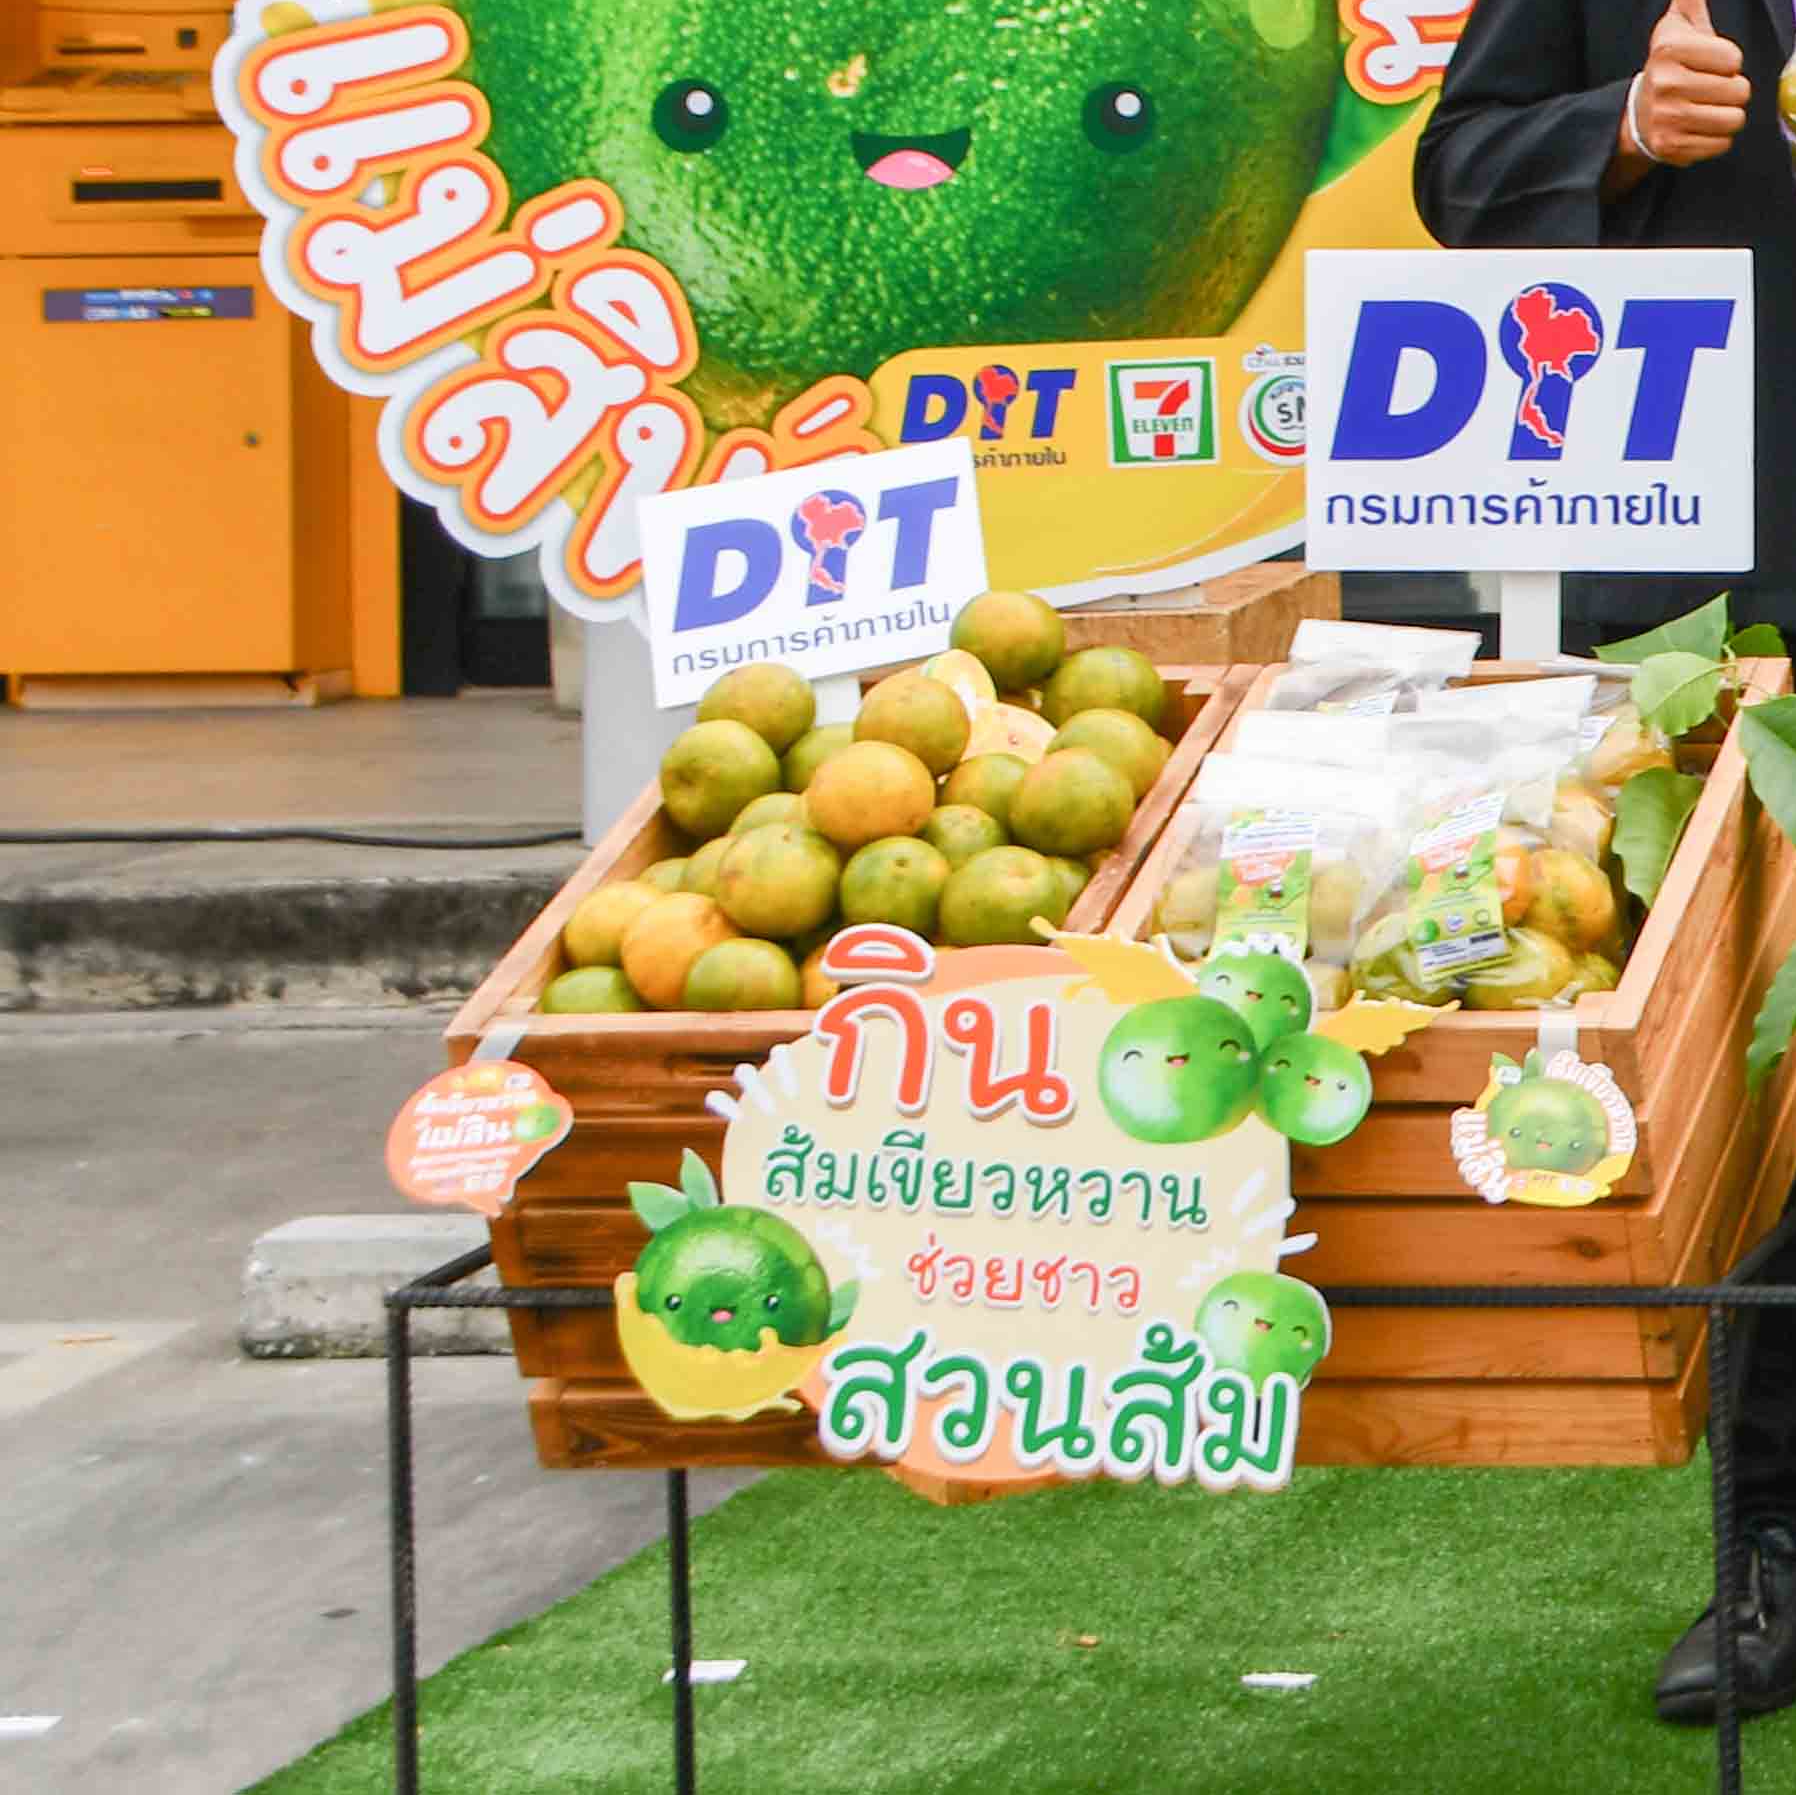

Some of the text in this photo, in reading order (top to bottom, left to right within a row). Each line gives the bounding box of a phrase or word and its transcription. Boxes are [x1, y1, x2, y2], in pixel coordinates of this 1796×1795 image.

[1326, 477, 1701, 527] กรมการค้าภายใน
[672, 601, 951, 677] กรมการค้าภายใน
[817, 930, 1073, 1114] กิน
[764, 1124, 1209, 1227] ส้มเขียวหวาน
[906, 1235, 1142, 1310] ช่วยชาว
[828, 1324, 1296, 1484] สวนส้ม
